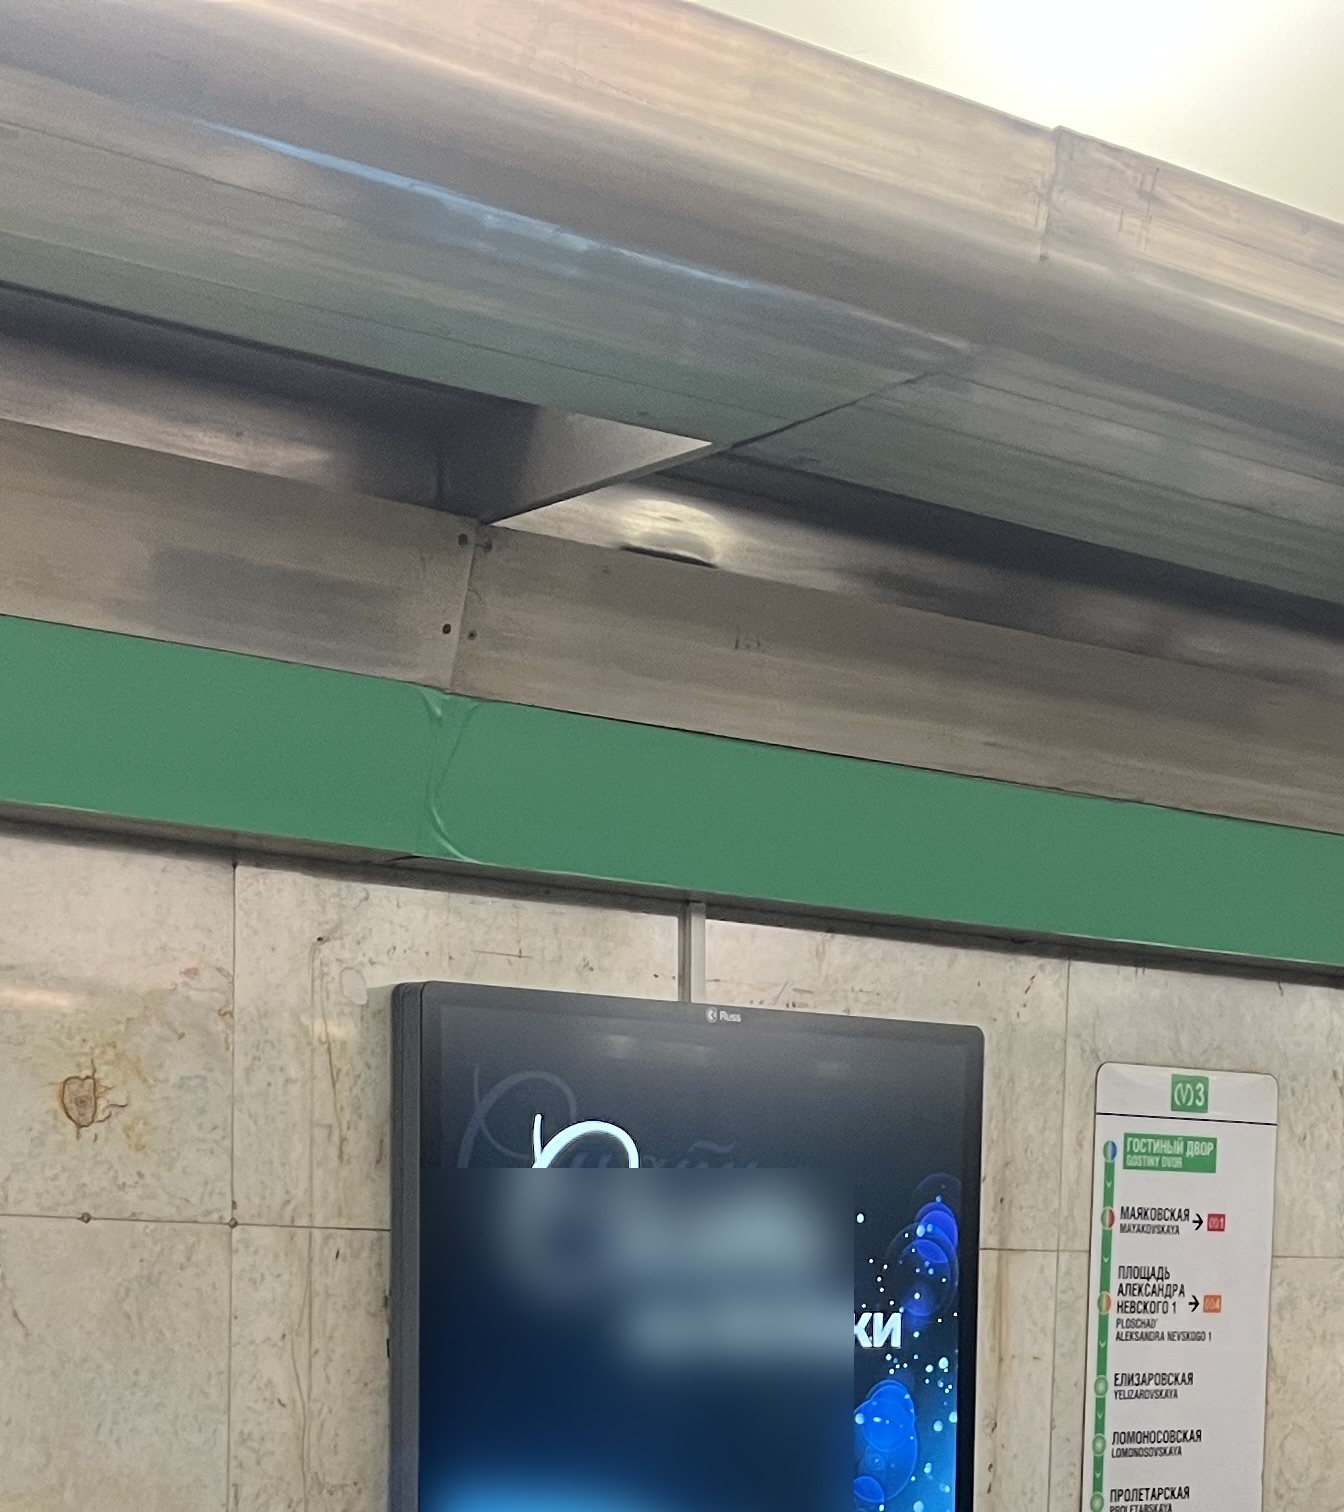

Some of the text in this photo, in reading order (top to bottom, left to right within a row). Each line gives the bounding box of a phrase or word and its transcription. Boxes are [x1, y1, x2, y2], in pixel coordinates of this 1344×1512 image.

[1126, 1137, 1214, 1158] ГОСТИНЫЙ ДВОР
[1126, 1154, 1183, 1168] GOSTINY DVOR
[1119, 1205, 1190, 1222] МАЯКОВСКАЯ
[1119, 1223, 1180, 1235] MAYAKOVSKAYA
[1117, 1265, 1171, 1282] ПЛОЩАДЬ
[1117, 1283, 1185, 1299] АЛЕКСАНДРА
[1116, 1300, 1177, 1314] НЕВСКОГО 1
[1115, 1331, 1165, 1342] ALEKSANDRA
[1166, 1331, 1206, 1342] NEVSKOGO
[1113, 1372, 1194, 1387] ЕЛИЗАРОВСКАЯ
[1113, 1389, 1178, 1400] YELIZAROVSKAYA
[1111, 1429, 1202, 1445] ЛОМОНОСОВСКАЯ
[1111, 1445, 1182, 1458] LOMONOSOVSKAYA
[1109, 1486, 1190, 1503] ПРОЛЕТАРСКАЯ
